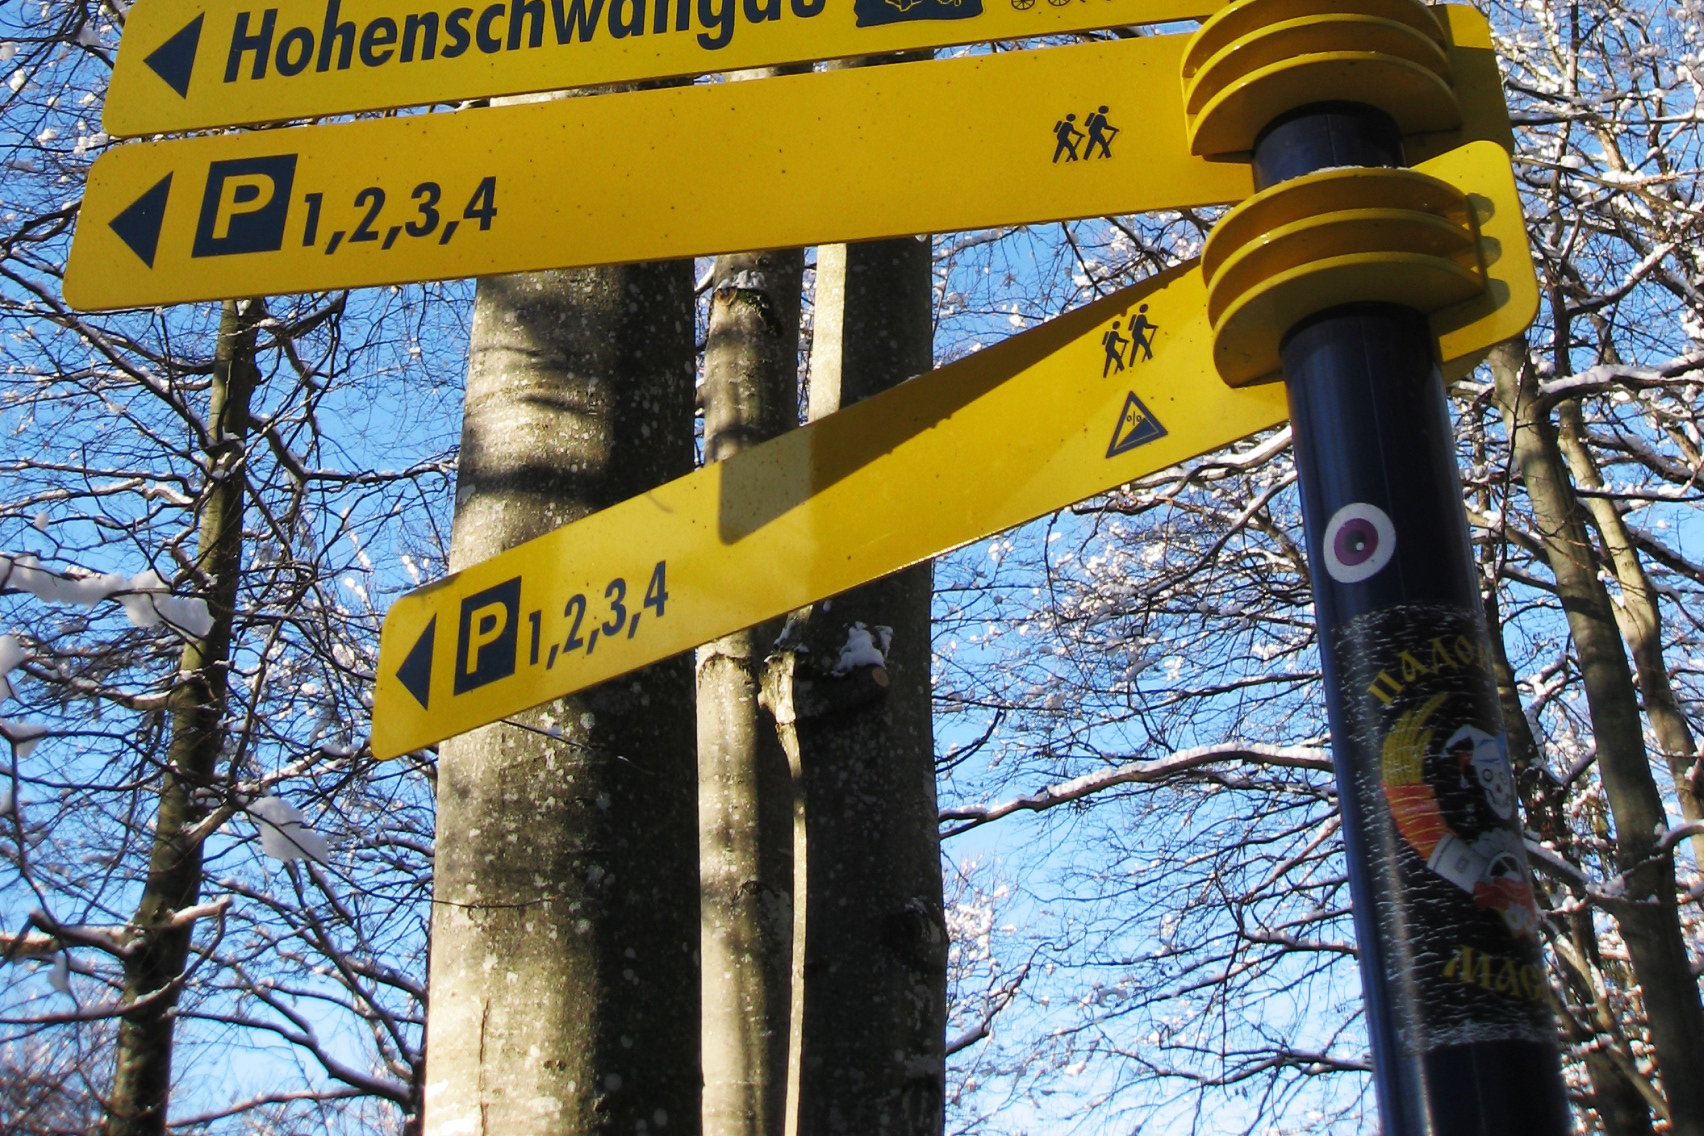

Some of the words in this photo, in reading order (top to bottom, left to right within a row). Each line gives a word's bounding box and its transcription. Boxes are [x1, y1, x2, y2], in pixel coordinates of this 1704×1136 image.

[211, 172, 275, 240] P
[301, 175, 498, 256] 1,2,3,4
[465, 600, 508, 676] P
[528, 559, 669, 671] 1,2,3,4
